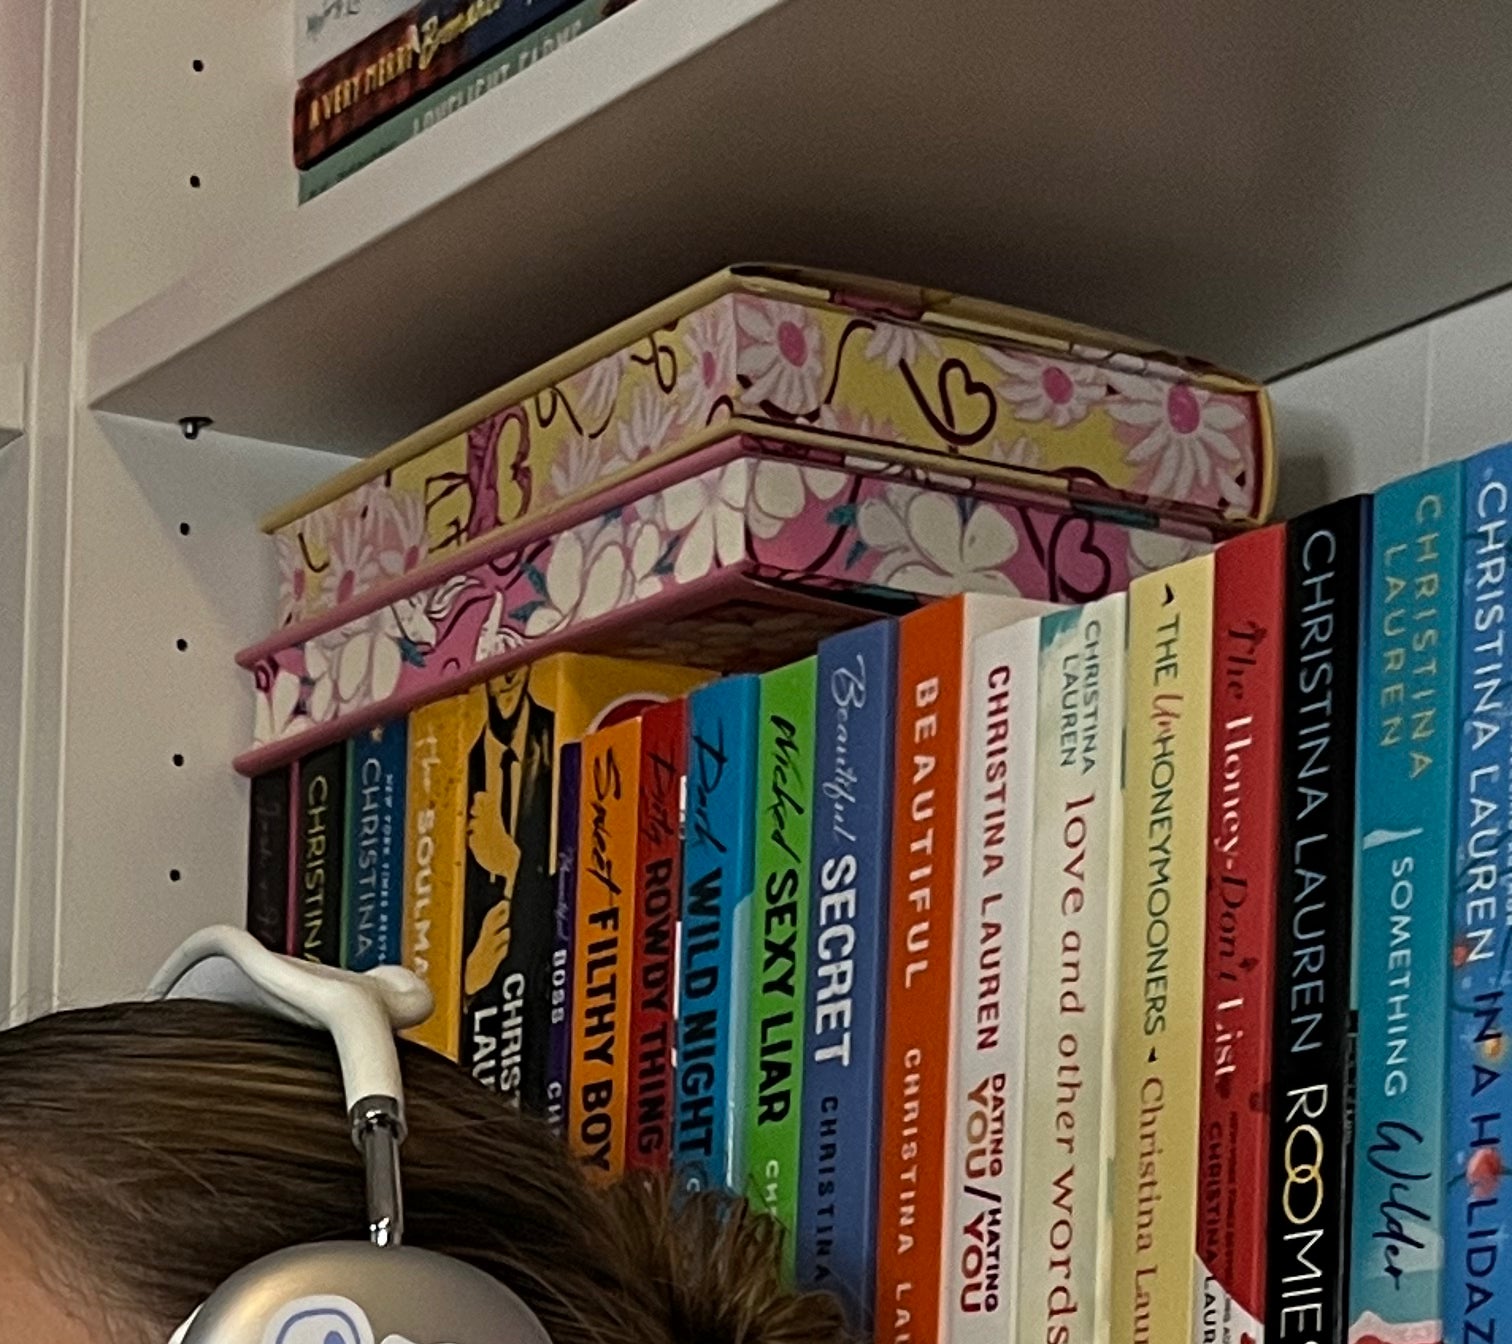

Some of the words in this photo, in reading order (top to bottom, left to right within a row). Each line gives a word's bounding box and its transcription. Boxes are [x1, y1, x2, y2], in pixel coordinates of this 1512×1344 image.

[1153, 613, 1181, 688] THE
[1296, 527, 1337, 822] CHRISTINA
[1379, 542, 1407, 748] LAUREN
[1408, 493, 1443, 779] CHRISTINA
[1471, 480, 1509, 752] CHRISTINA
[823, 653, 868, 844] Beautiful
[981, 664, 1011, 877] CHRISTINA
[1059, 653, 1079, 768] LAUREN
[1081, 619, 1102, 777] CHRISTINA
[357, 756, 383, 958] CHRISTINA
[769, 713, 807, 865] Wicked
[904, 675, 940, 991] BEAUTIFUL
[1061, 794, 1096, 918] love
[1465, 764, 1501, 963] LAUREN
[582, 905, 621, 1067] FILTHY
[640, 857, 674, 1012] ROWDY
[684, 866, 723, 1001] WILD
[762, 870, 800, 998] SEXY
[814, 854, 859, 1068] SECRET
[976, 892, 1004, 1051] LAUREN
[1059, 930, 1086, 1017] and
[1289, 833, 1329, 1054] LAUREN
[1383, 856, 1415, 1097] SOMETHING
[637, 1019, 669, 1156] THING
[678, 1008, 718, 1158] NIGHT
[756, 1011, 794, 1127] LIAR
[1055, 1034, 1084, 1157] other
[1471, 991, 1504, 1057] IN
[1471, 1062, 1502, 1098] A
[579, 1078, 615, 1173] BOY
[815, 1095, 840, 1283] CHRISTINA
[897, 1047, 922, 1256] CHRISTINA
[965, 1075, 990, 1180] YOU
[989, 1072, 1008, 1178] DATING
[1135, 1076, 1166, 1254] Christina
[960, 1211, 985, 1314] YOU
[984, 1206, 1002, 1314] HATING
[1365, 1120, 1433, 1291] Wilder
